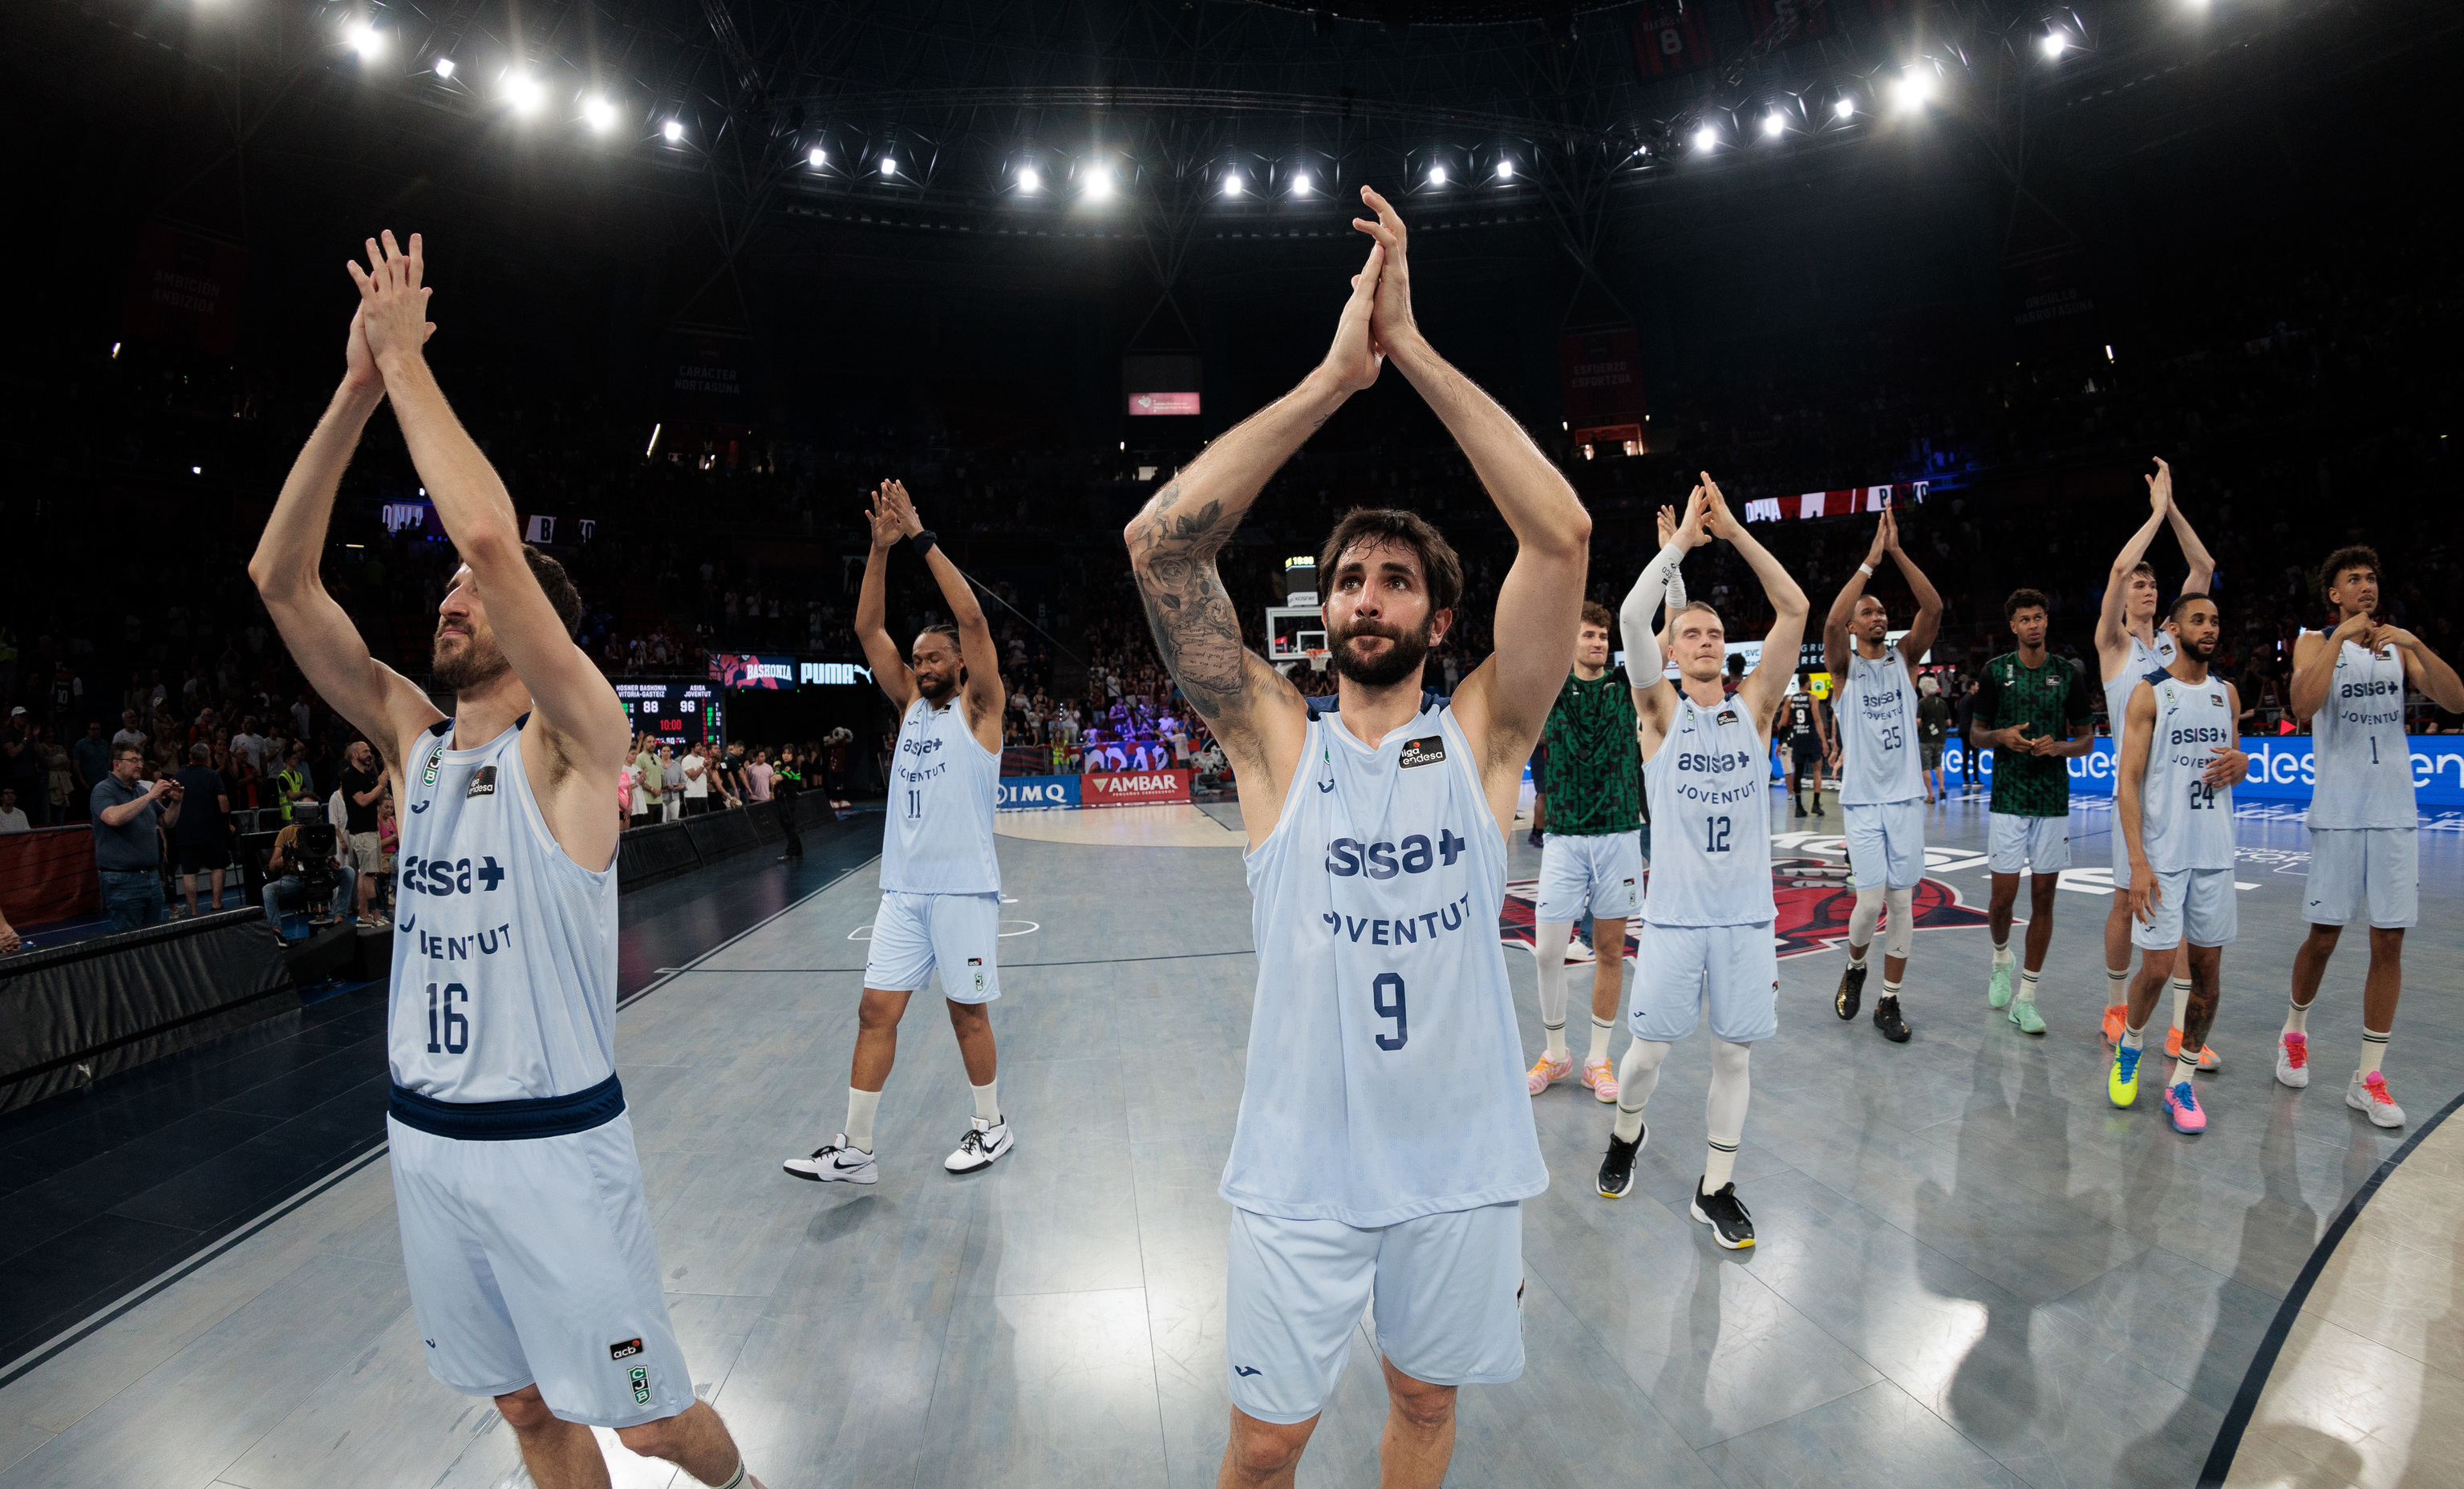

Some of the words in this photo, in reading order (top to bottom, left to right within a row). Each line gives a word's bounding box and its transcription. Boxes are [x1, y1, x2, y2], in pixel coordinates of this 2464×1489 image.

[1660, 29, 1683, 55] 8
[679, 364, 737, 382] CARÁCTER
[674, 378, 740, 395] NORTASUNA
[746, 663, 792, 681] BASKONIA
[800, 662, 855, 685] PUMA
[639, 684, 667, 692] BASKONIA
[643, 700, 659, 713] 88
[680, 700, 695, 713] 96
[660, 718, 683, 730] 10:00
[1796, 709, 1806, 724] 9
[1882, 726, 1902, 751] 25
[1401, 747, 1420, 758] liga
[1403, 751, 1443, 765] endesa
[2370, 735, 2380, 765] 1
[1010, 783, 1067, 803] IMQ
[1108, 774, 1178, 793] AMBAR
[1677, 780, 1756, 804] JOVENTUT
[908, 789, 921, 819] 11
[2190, 780, 2215, 810] 24
[1706, 815, 1731, 852] 12
[426, 982, 468, 1054] 16
[1372, 972, 1408, 1051] 9
[614, 1346, 636, 1358] acb
